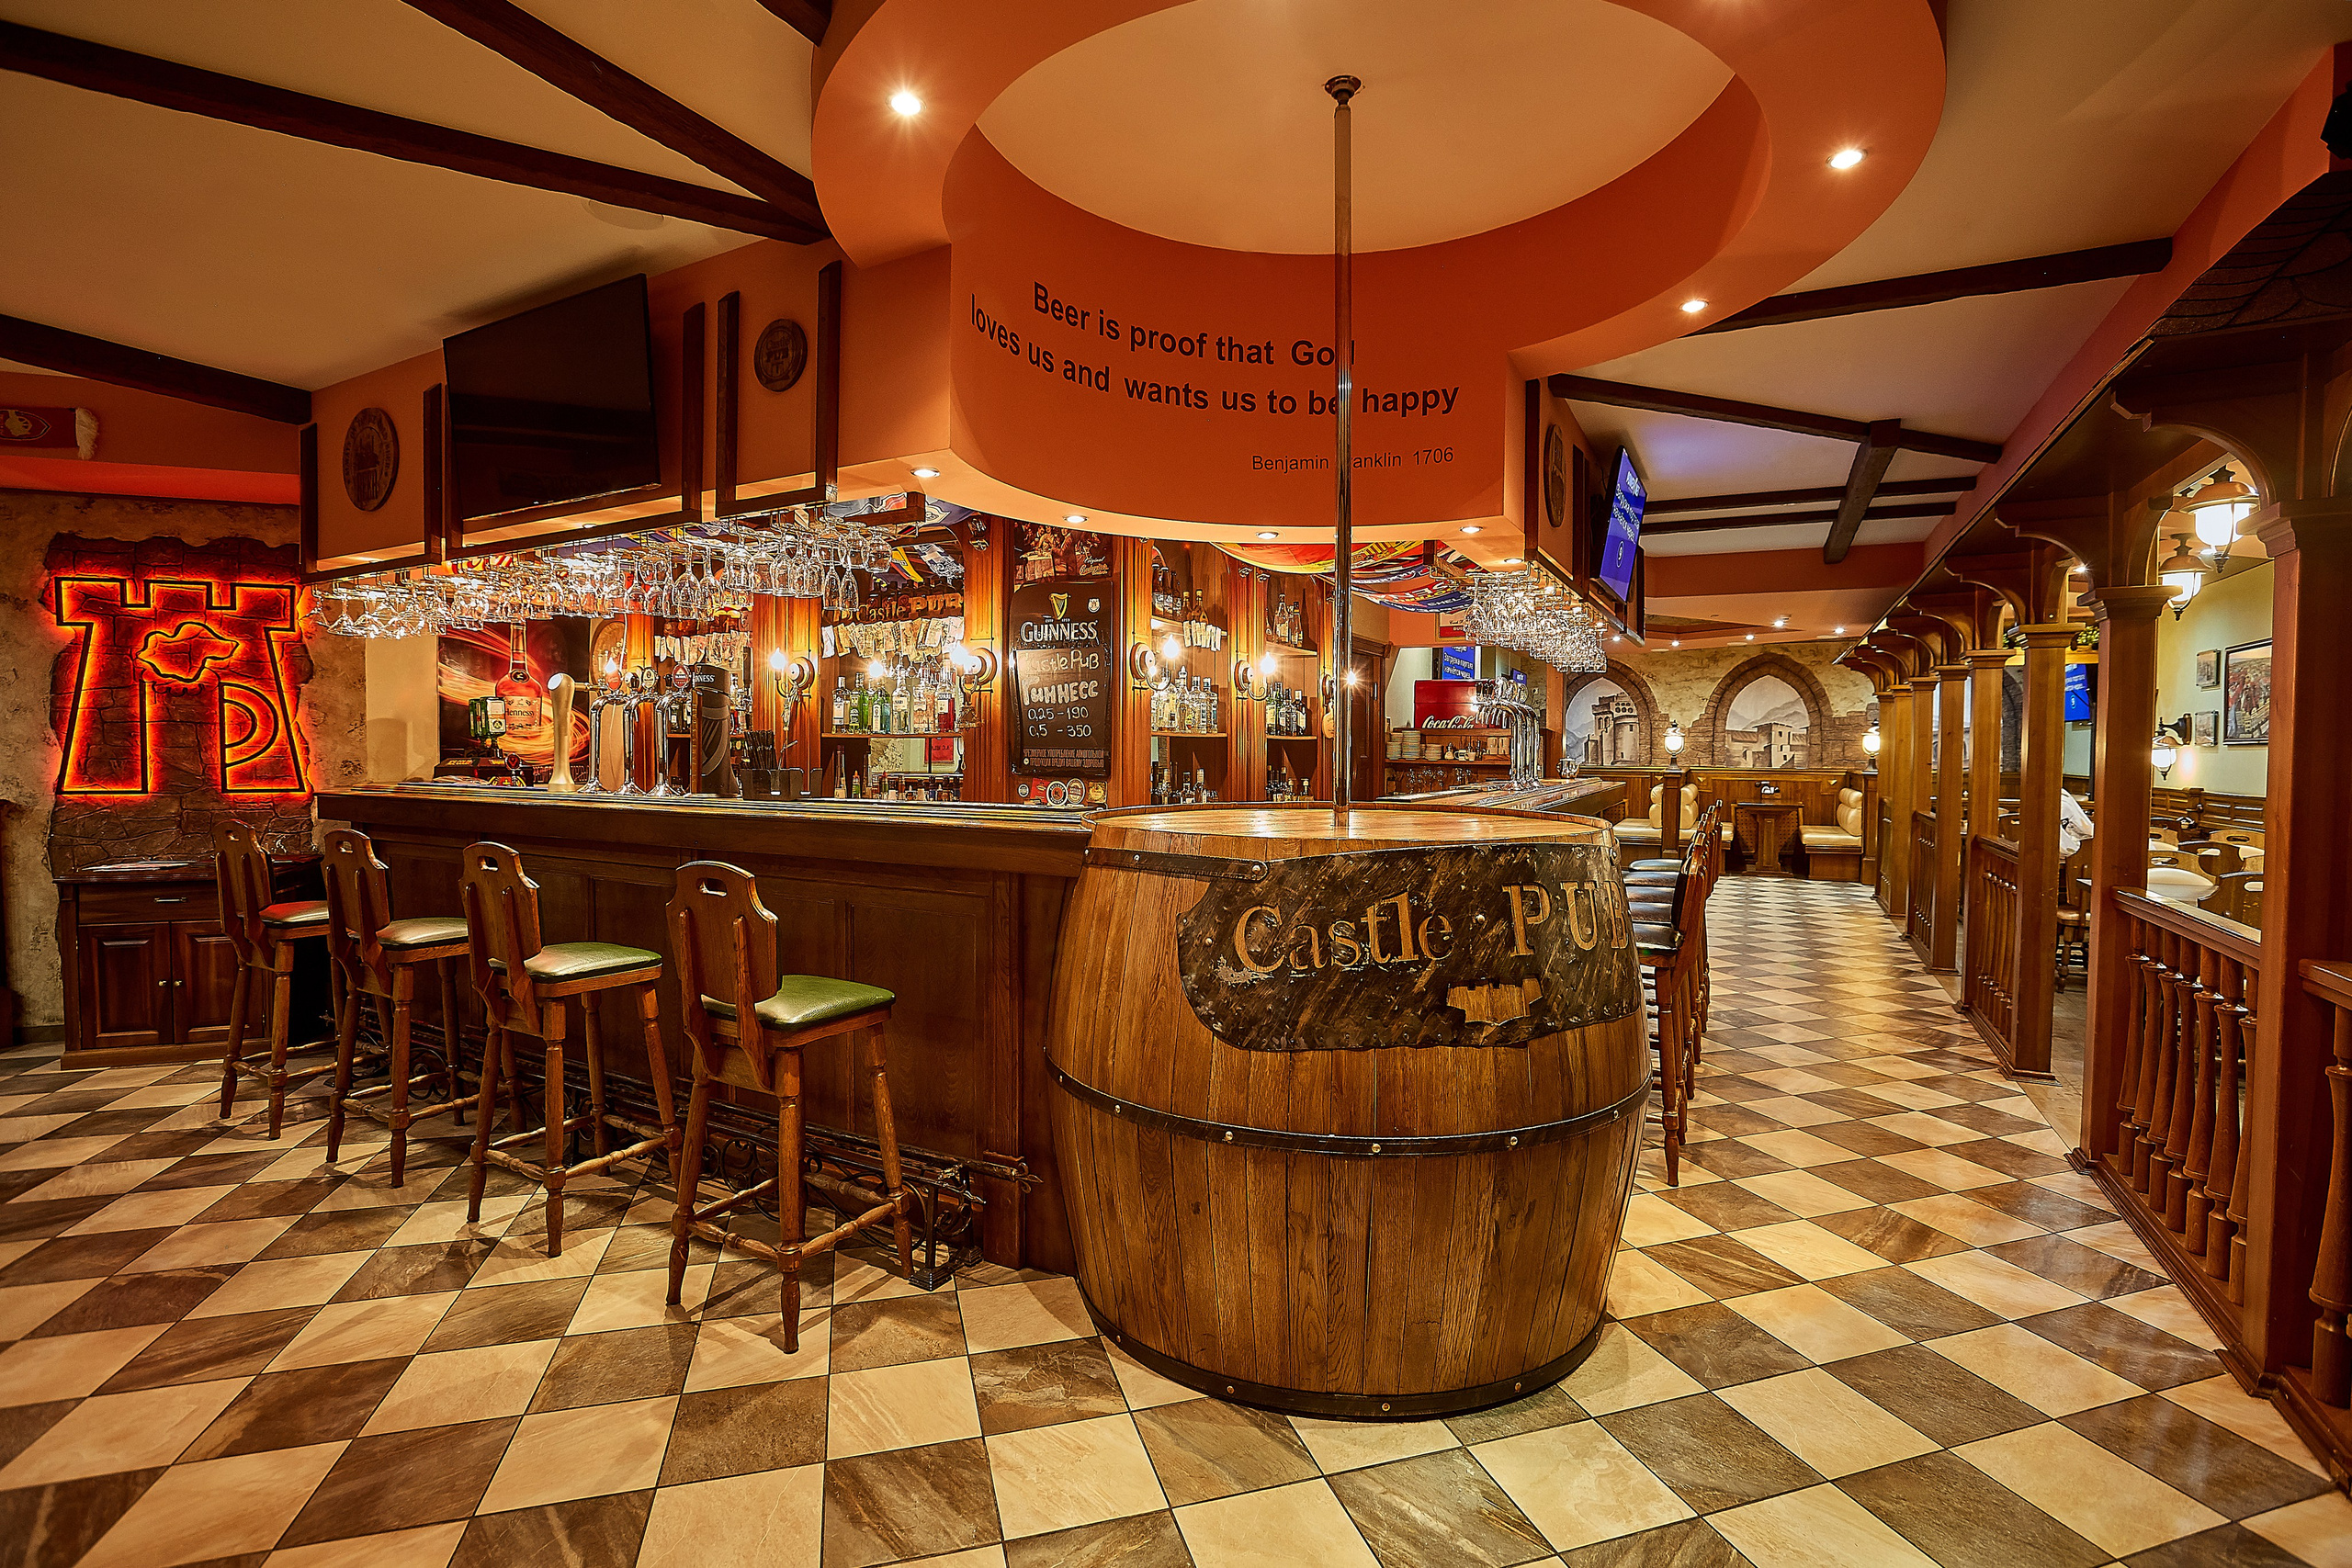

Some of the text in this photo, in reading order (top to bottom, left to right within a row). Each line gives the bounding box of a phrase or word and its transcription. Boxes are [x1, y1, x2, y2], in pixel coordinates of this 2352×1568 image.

[1033, 280, 1091, 331] Beer
[1099, 308, 1120, 341] is
[1129, 324, 1208, 359] proof
[1216, 335, 1274, 366] that
[970, 292, 1021, 356] loves
[1027, 341, 1055, 373] us
[1062, 358, 1111, 393] and
[1124, 377, 1209, 411] wants
[1221, 389, 1257, 412] us
[1267, 389, 1297, 414] to
[1361, 386, 1460, 418] happy
[1251, 446, 1454, 474] Benjamin anklin 1706
[855, 592, 964, 623] Castle PUB
[1020, 621, 1098, 643] GUINNESS
[695, 674, 716, 683] NNESS
[1028, 706, 1055, 722] 0,25
[1066, 705, 1089, 720] 190
[1029, 723, 1048, 738] 0,5
[1066, 724, 1091, 738] 350
[1233, 887, 1455, 974] Castle
